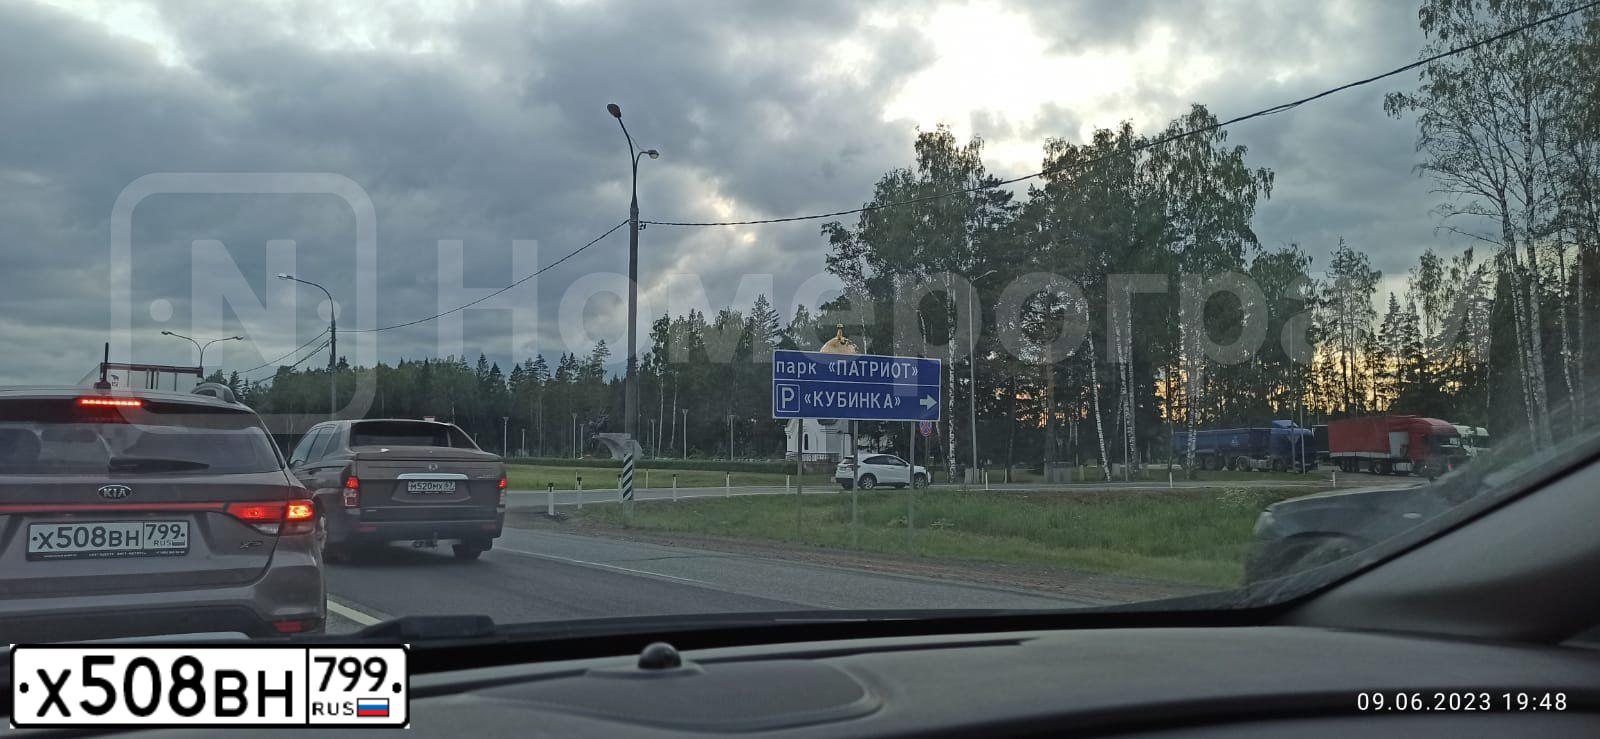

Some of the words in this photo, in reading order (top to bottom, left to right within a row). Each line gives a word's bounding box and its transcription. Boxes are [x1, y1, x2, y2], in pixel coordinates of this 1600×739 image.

[776, 360, 817, 378] парк
[828, 359, 919, 379] «ПАТРИОТ»
[804, 390, 901, 409] «КУБИНКА»
[103, 487, 127, 498] KIA
[145, 523, 181, 540] 799
